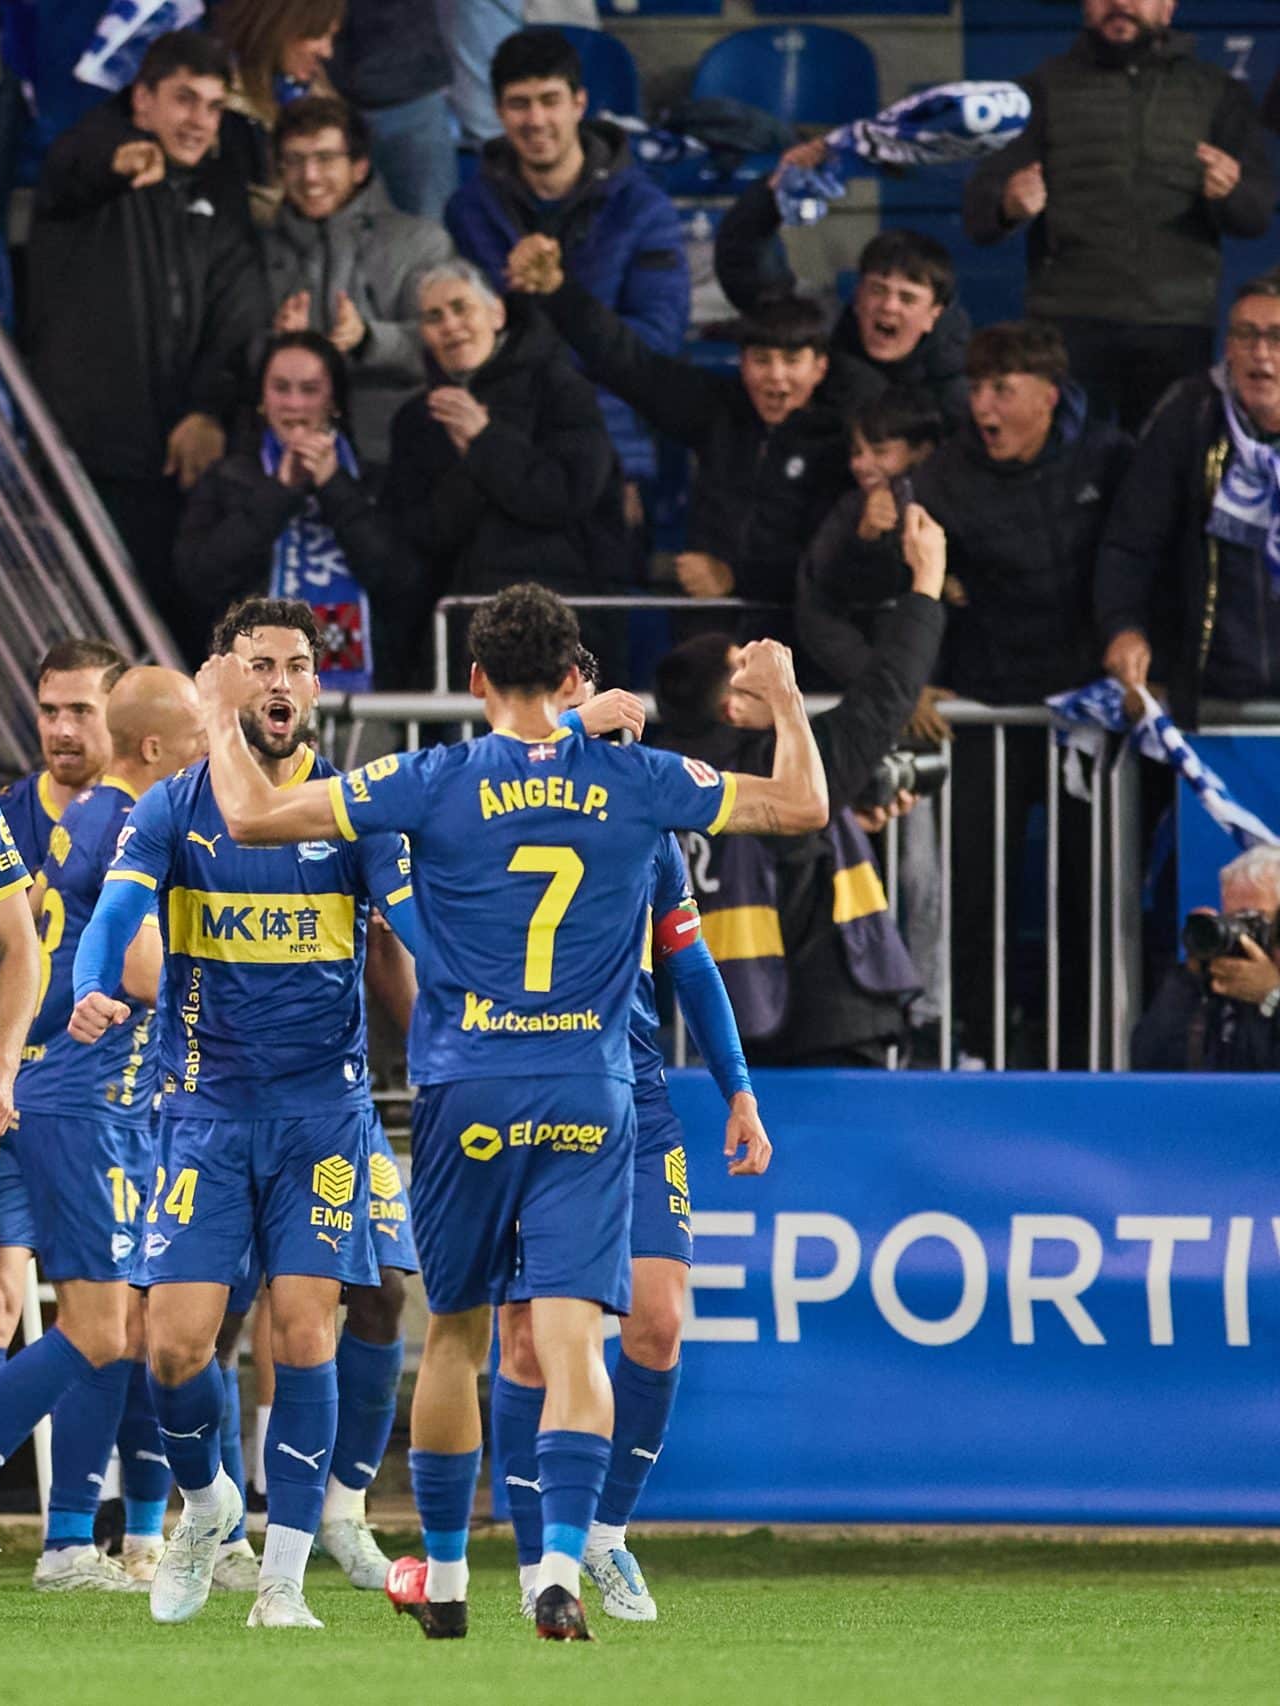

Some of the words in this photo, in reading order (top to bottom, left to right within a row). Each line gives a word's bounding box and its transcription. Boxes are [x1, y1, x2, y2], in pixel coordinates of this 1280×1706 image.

[479, 776, 580, 820] ÁNGEL
[582, 784, 609, 821] P.
[507, 845, 585, 992] 7
[461, 991, 602, 1032] Kutxabank
[310, 1206, 353, 1232] EMB
[603, 1210, 1280, 1346] EPORTI
